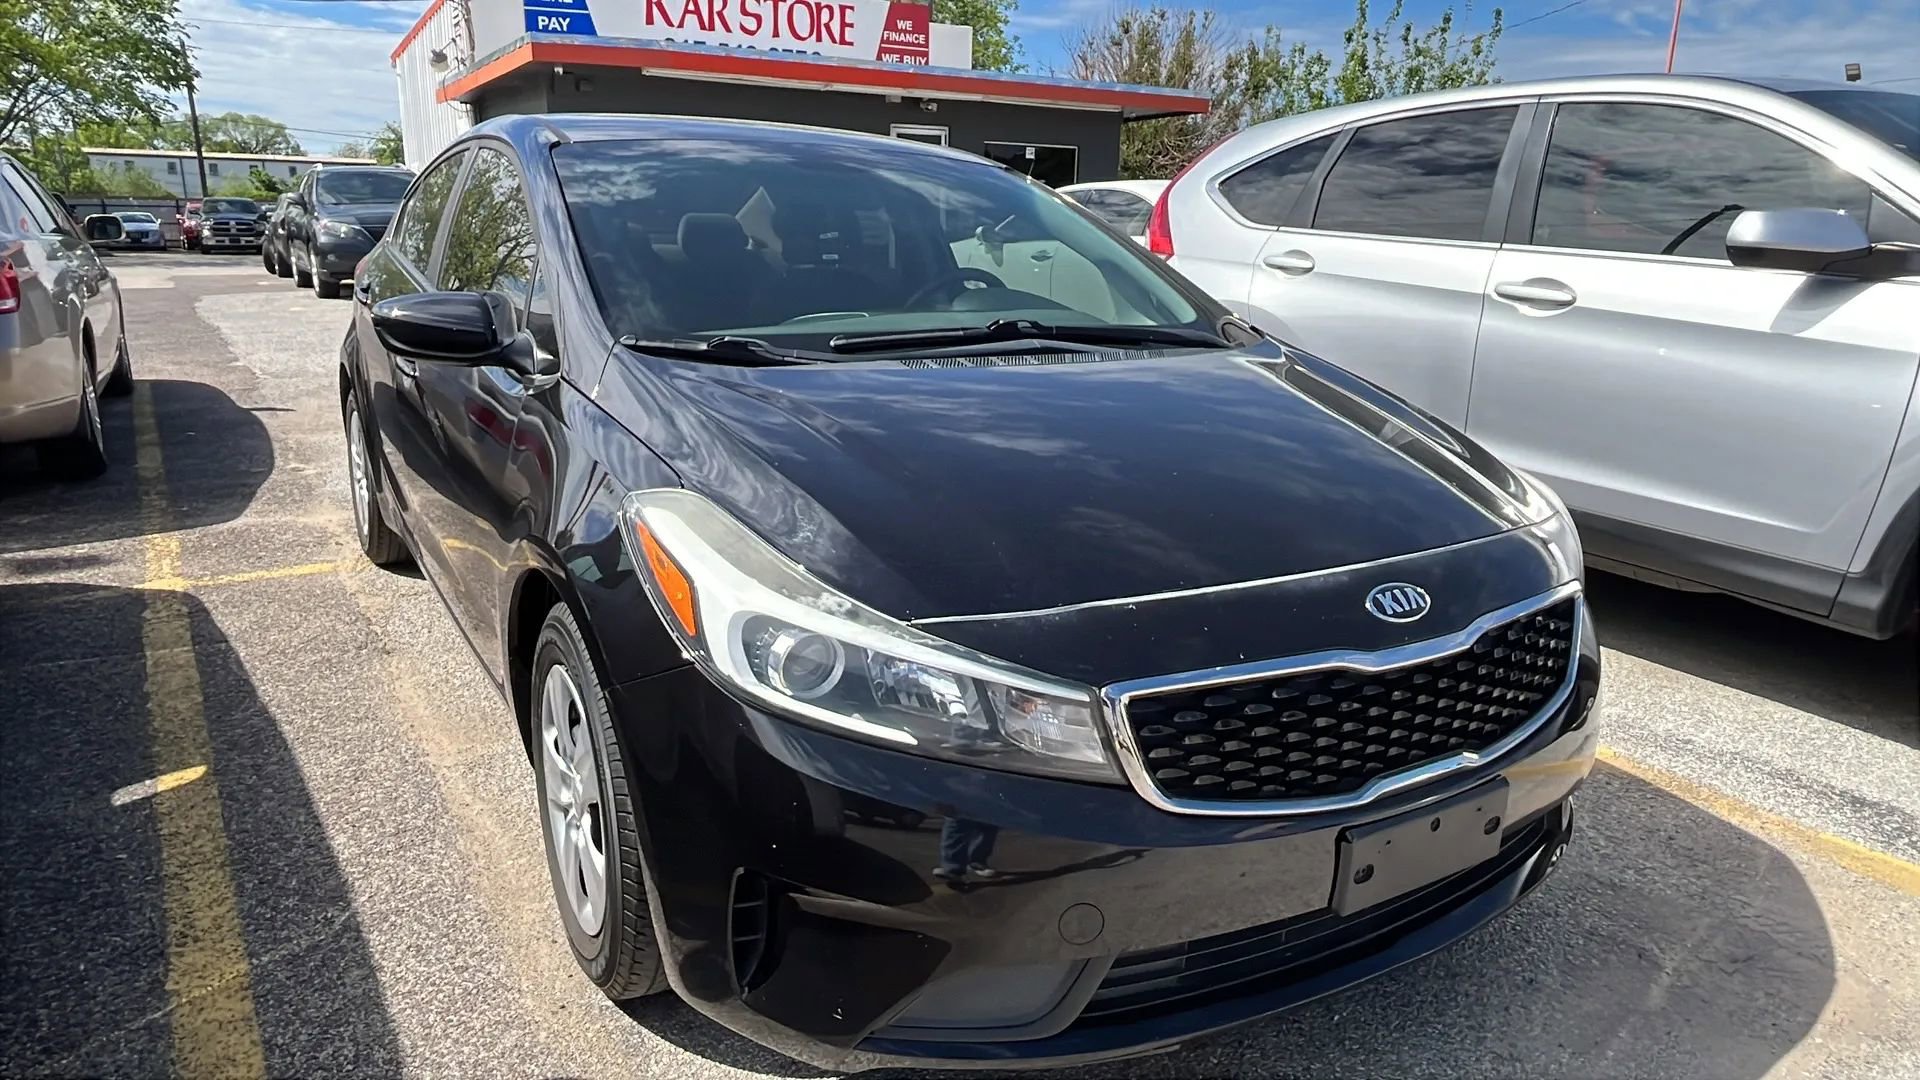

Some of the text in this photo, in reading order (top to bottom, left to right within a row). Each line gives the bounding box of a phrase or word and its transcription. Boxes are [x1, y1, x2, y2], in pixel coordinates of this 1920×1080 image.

[537, 15, 571, 32] PAY
[645, 0, 855, 46] KAR STORE
[896, 19, 913, 31] WE
[883, 30, 926, 44] FINANCE
[881, 53, 927, 66] WE BUY
[1375, 587, 1426, 615] KIA
